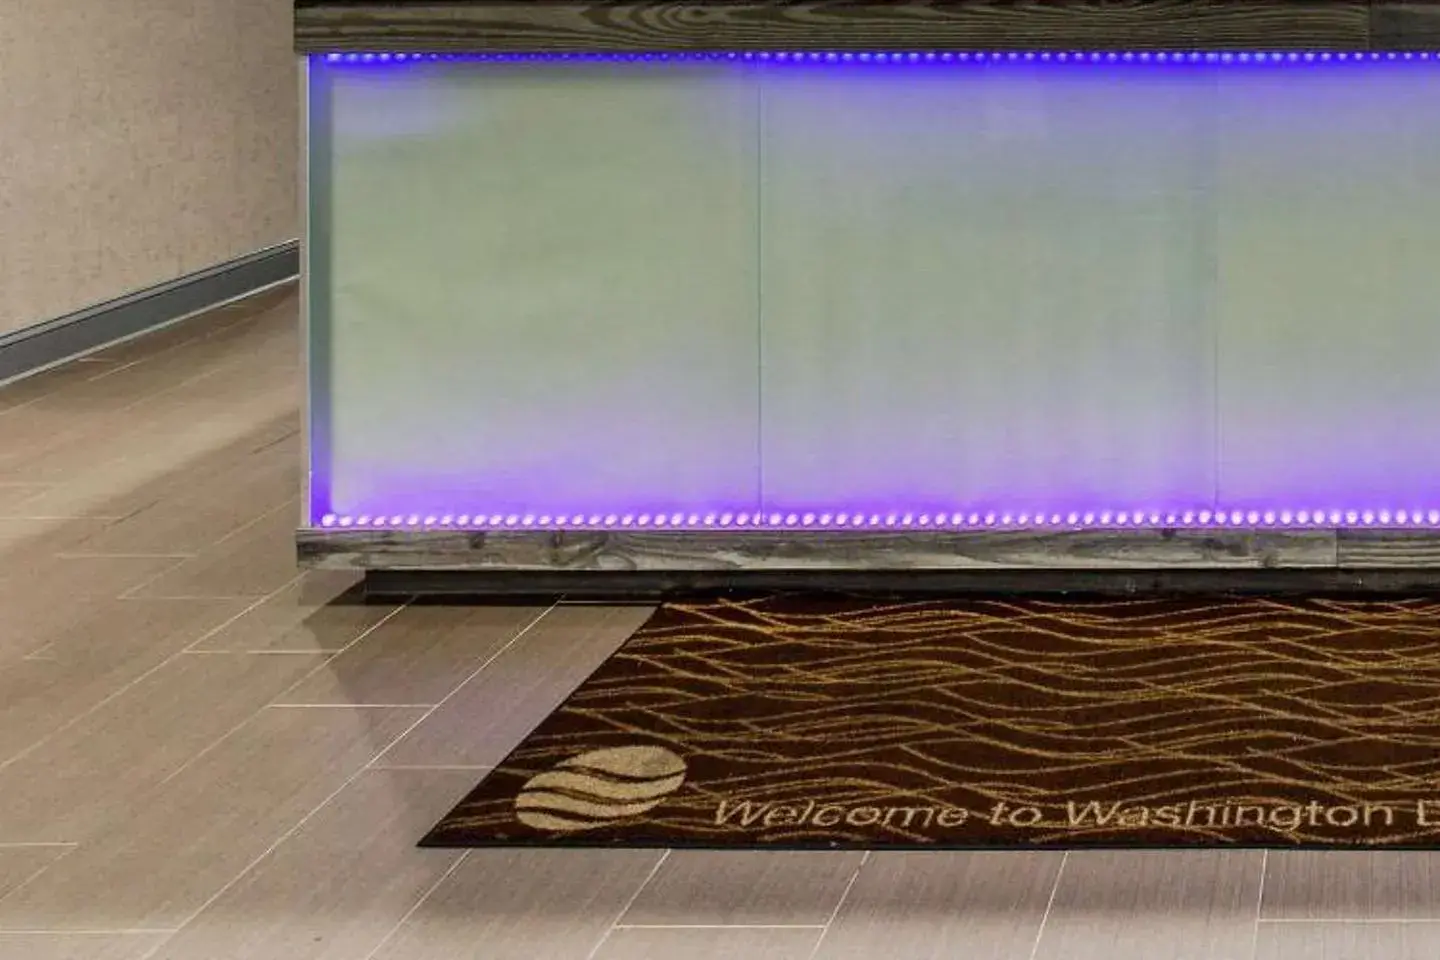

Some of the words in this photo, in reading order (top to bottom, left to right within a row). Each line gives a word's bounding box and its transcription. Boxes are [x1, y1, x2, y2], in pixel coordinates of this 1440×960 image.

[712, 798, 969, 828] Welcome
[988, 800, 1044, 828] to
[1065, 798, 1394, 830] Washington
